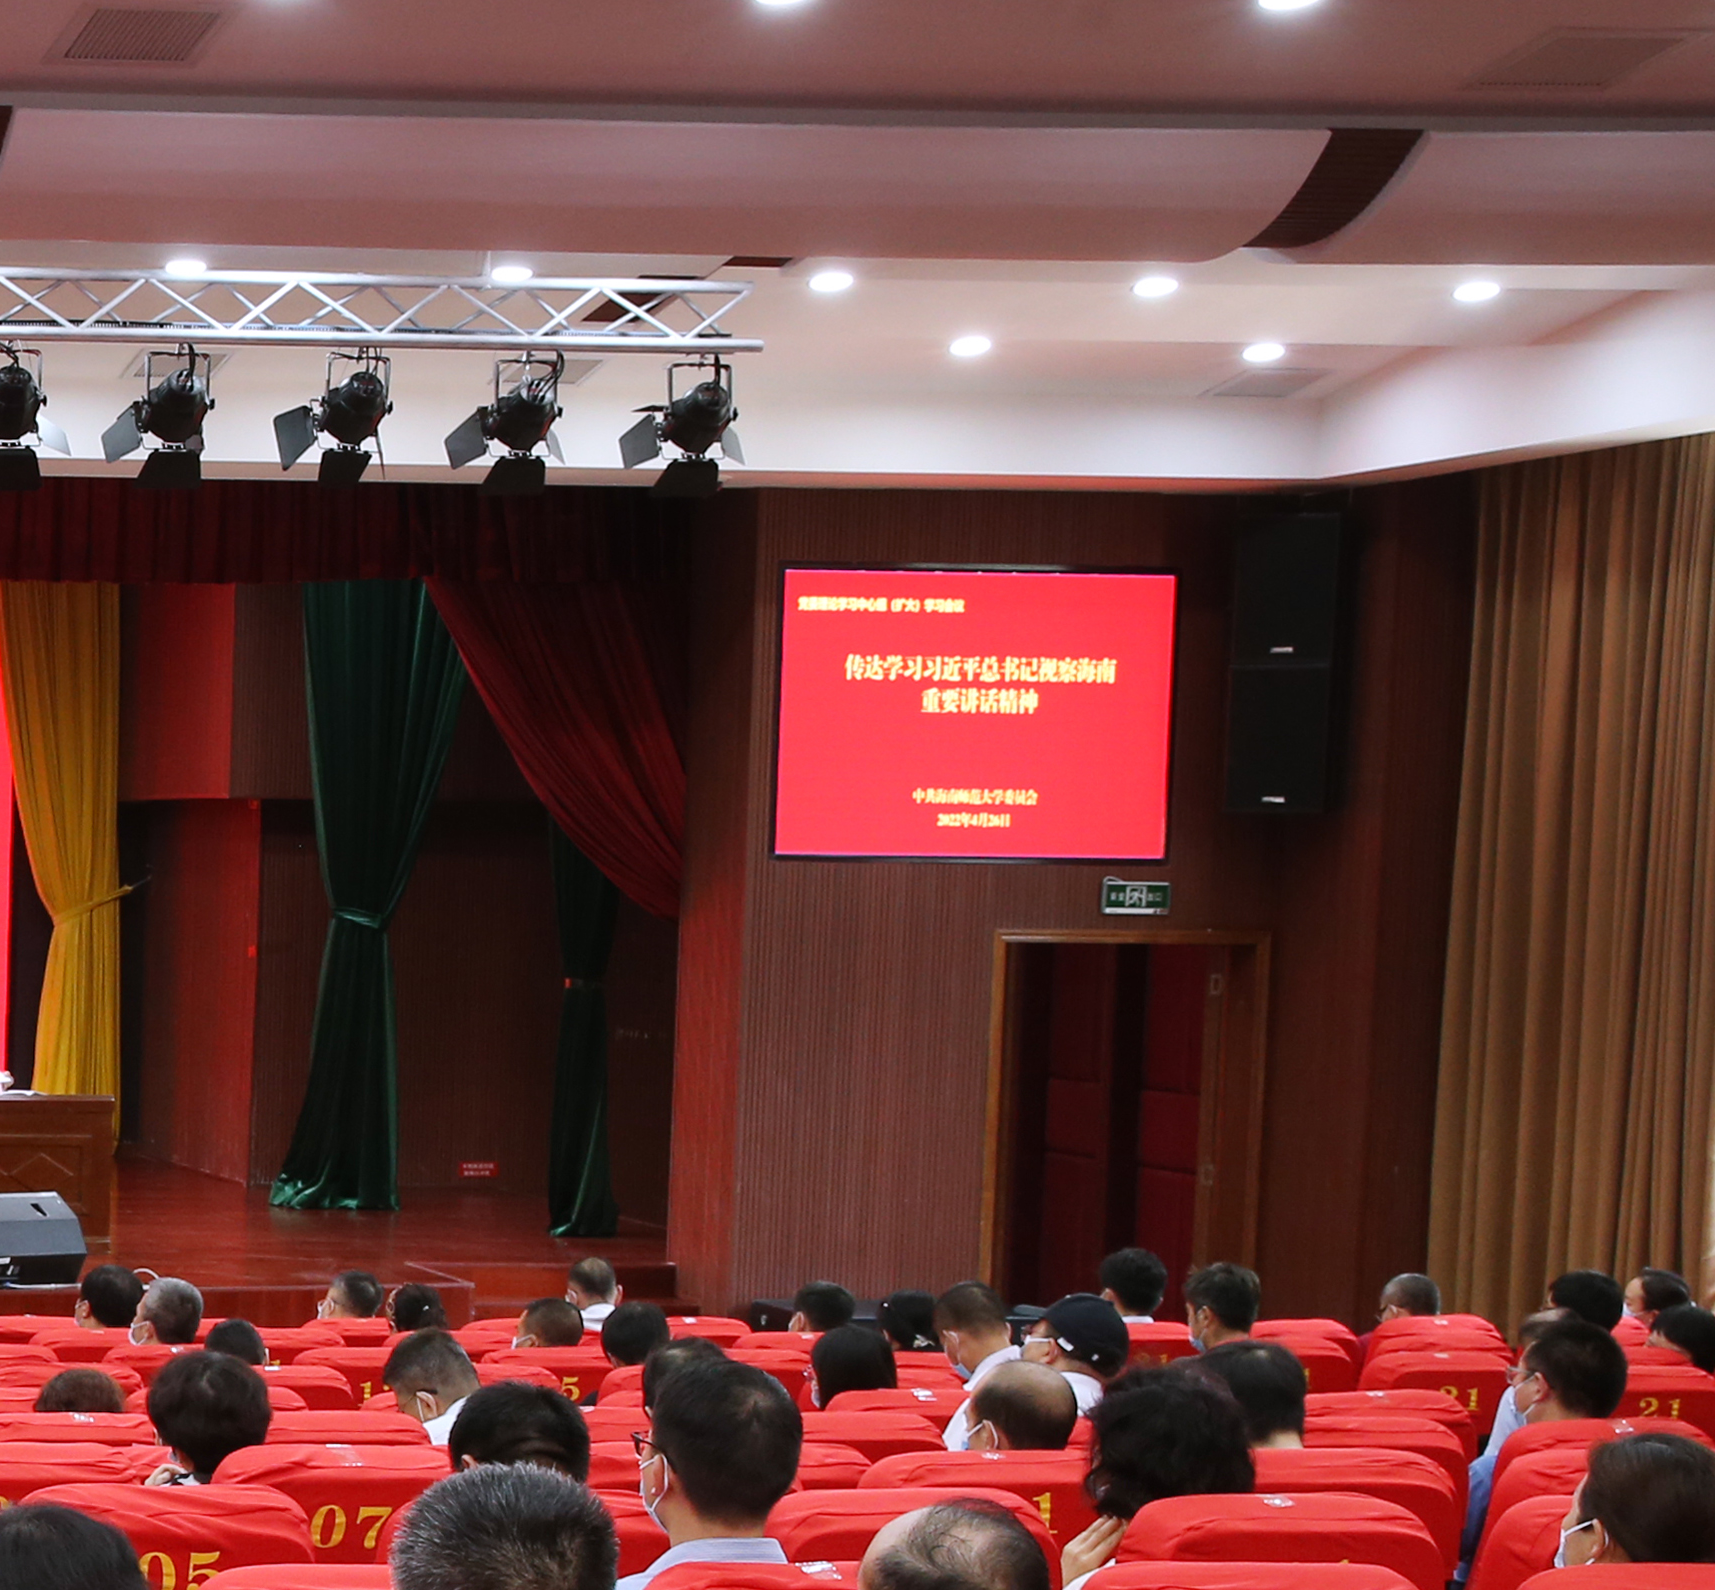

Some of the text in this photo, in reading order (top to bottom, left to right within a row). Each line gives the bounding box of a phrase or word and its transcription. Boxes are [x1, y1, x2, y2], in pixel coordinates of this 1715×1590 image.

[844, 653, 1118, 684] 传达学习习近平总书记视察海南
[920, 686, 1039, 715] 重要讲话精神
[311, 1504, 393, 1549] 07
